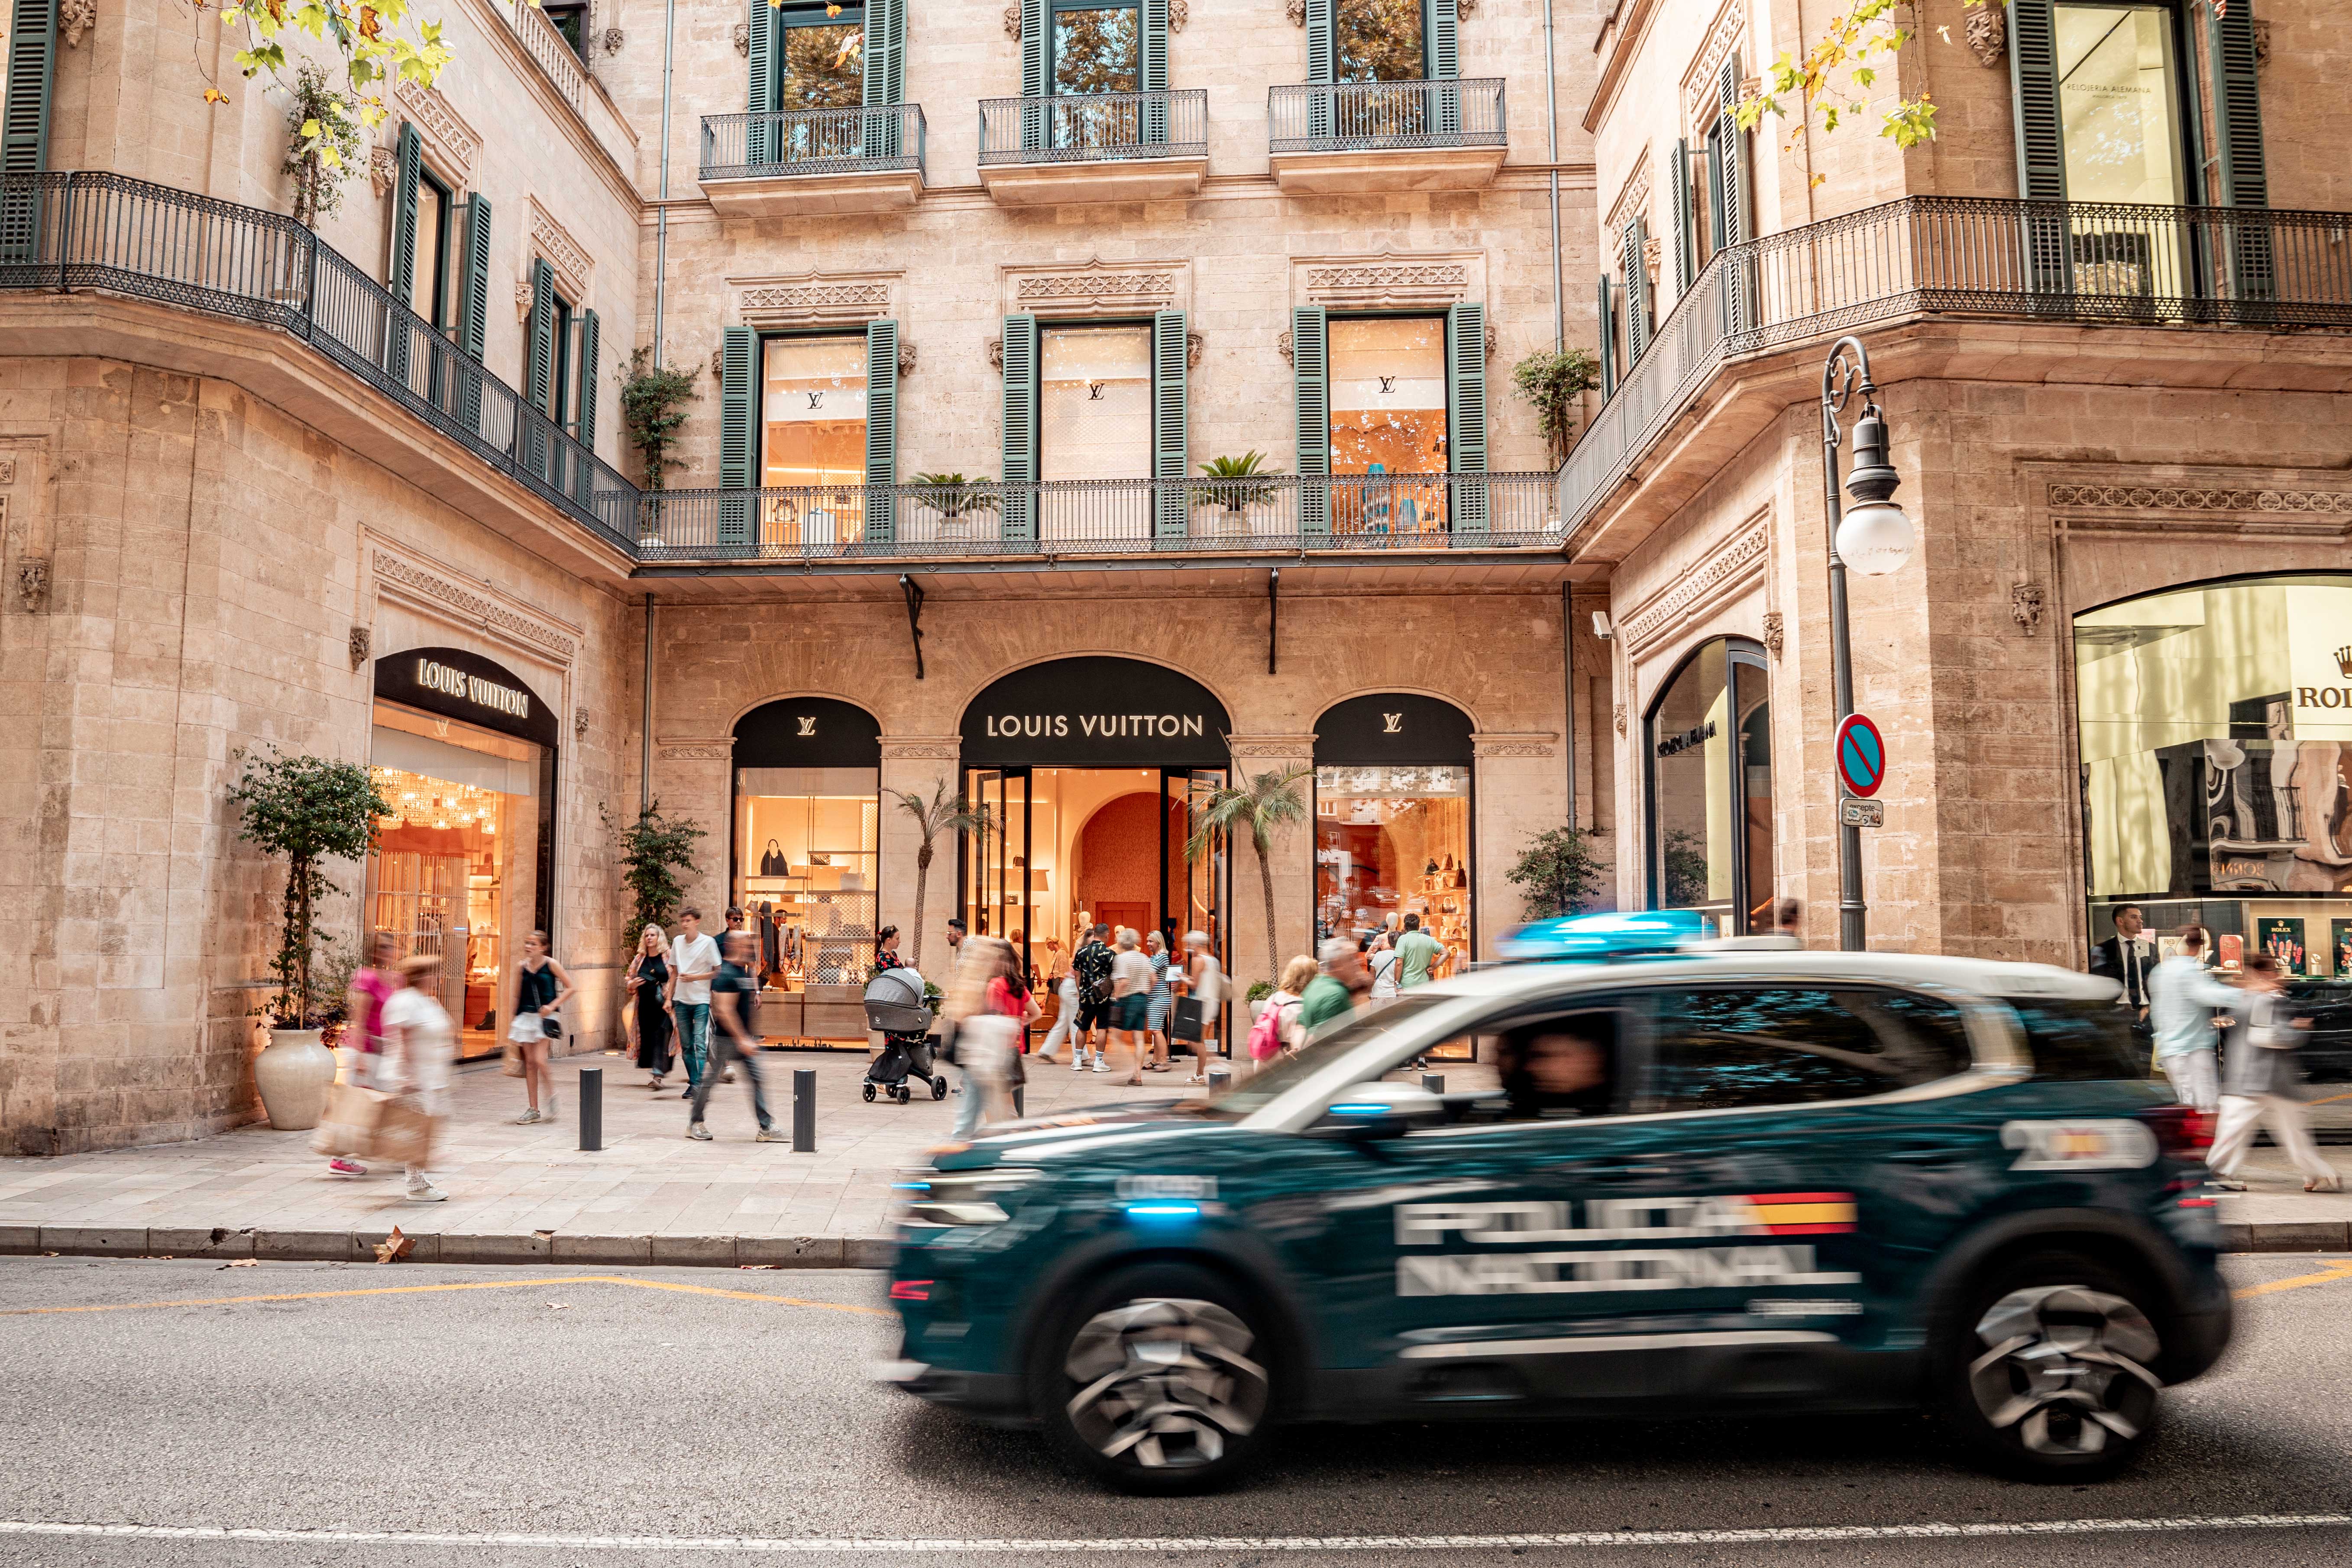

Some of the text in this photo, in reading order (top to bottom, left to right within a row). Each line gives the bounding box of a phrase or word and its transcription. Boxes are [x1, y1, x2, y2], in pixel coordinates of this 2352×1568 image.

[2111, 86, 2151, 94] ALEMANA
[419, 658, 528, 718] LOUIS VUITTON
[987, 714, 1202, 737] LOUIS VUITTON
